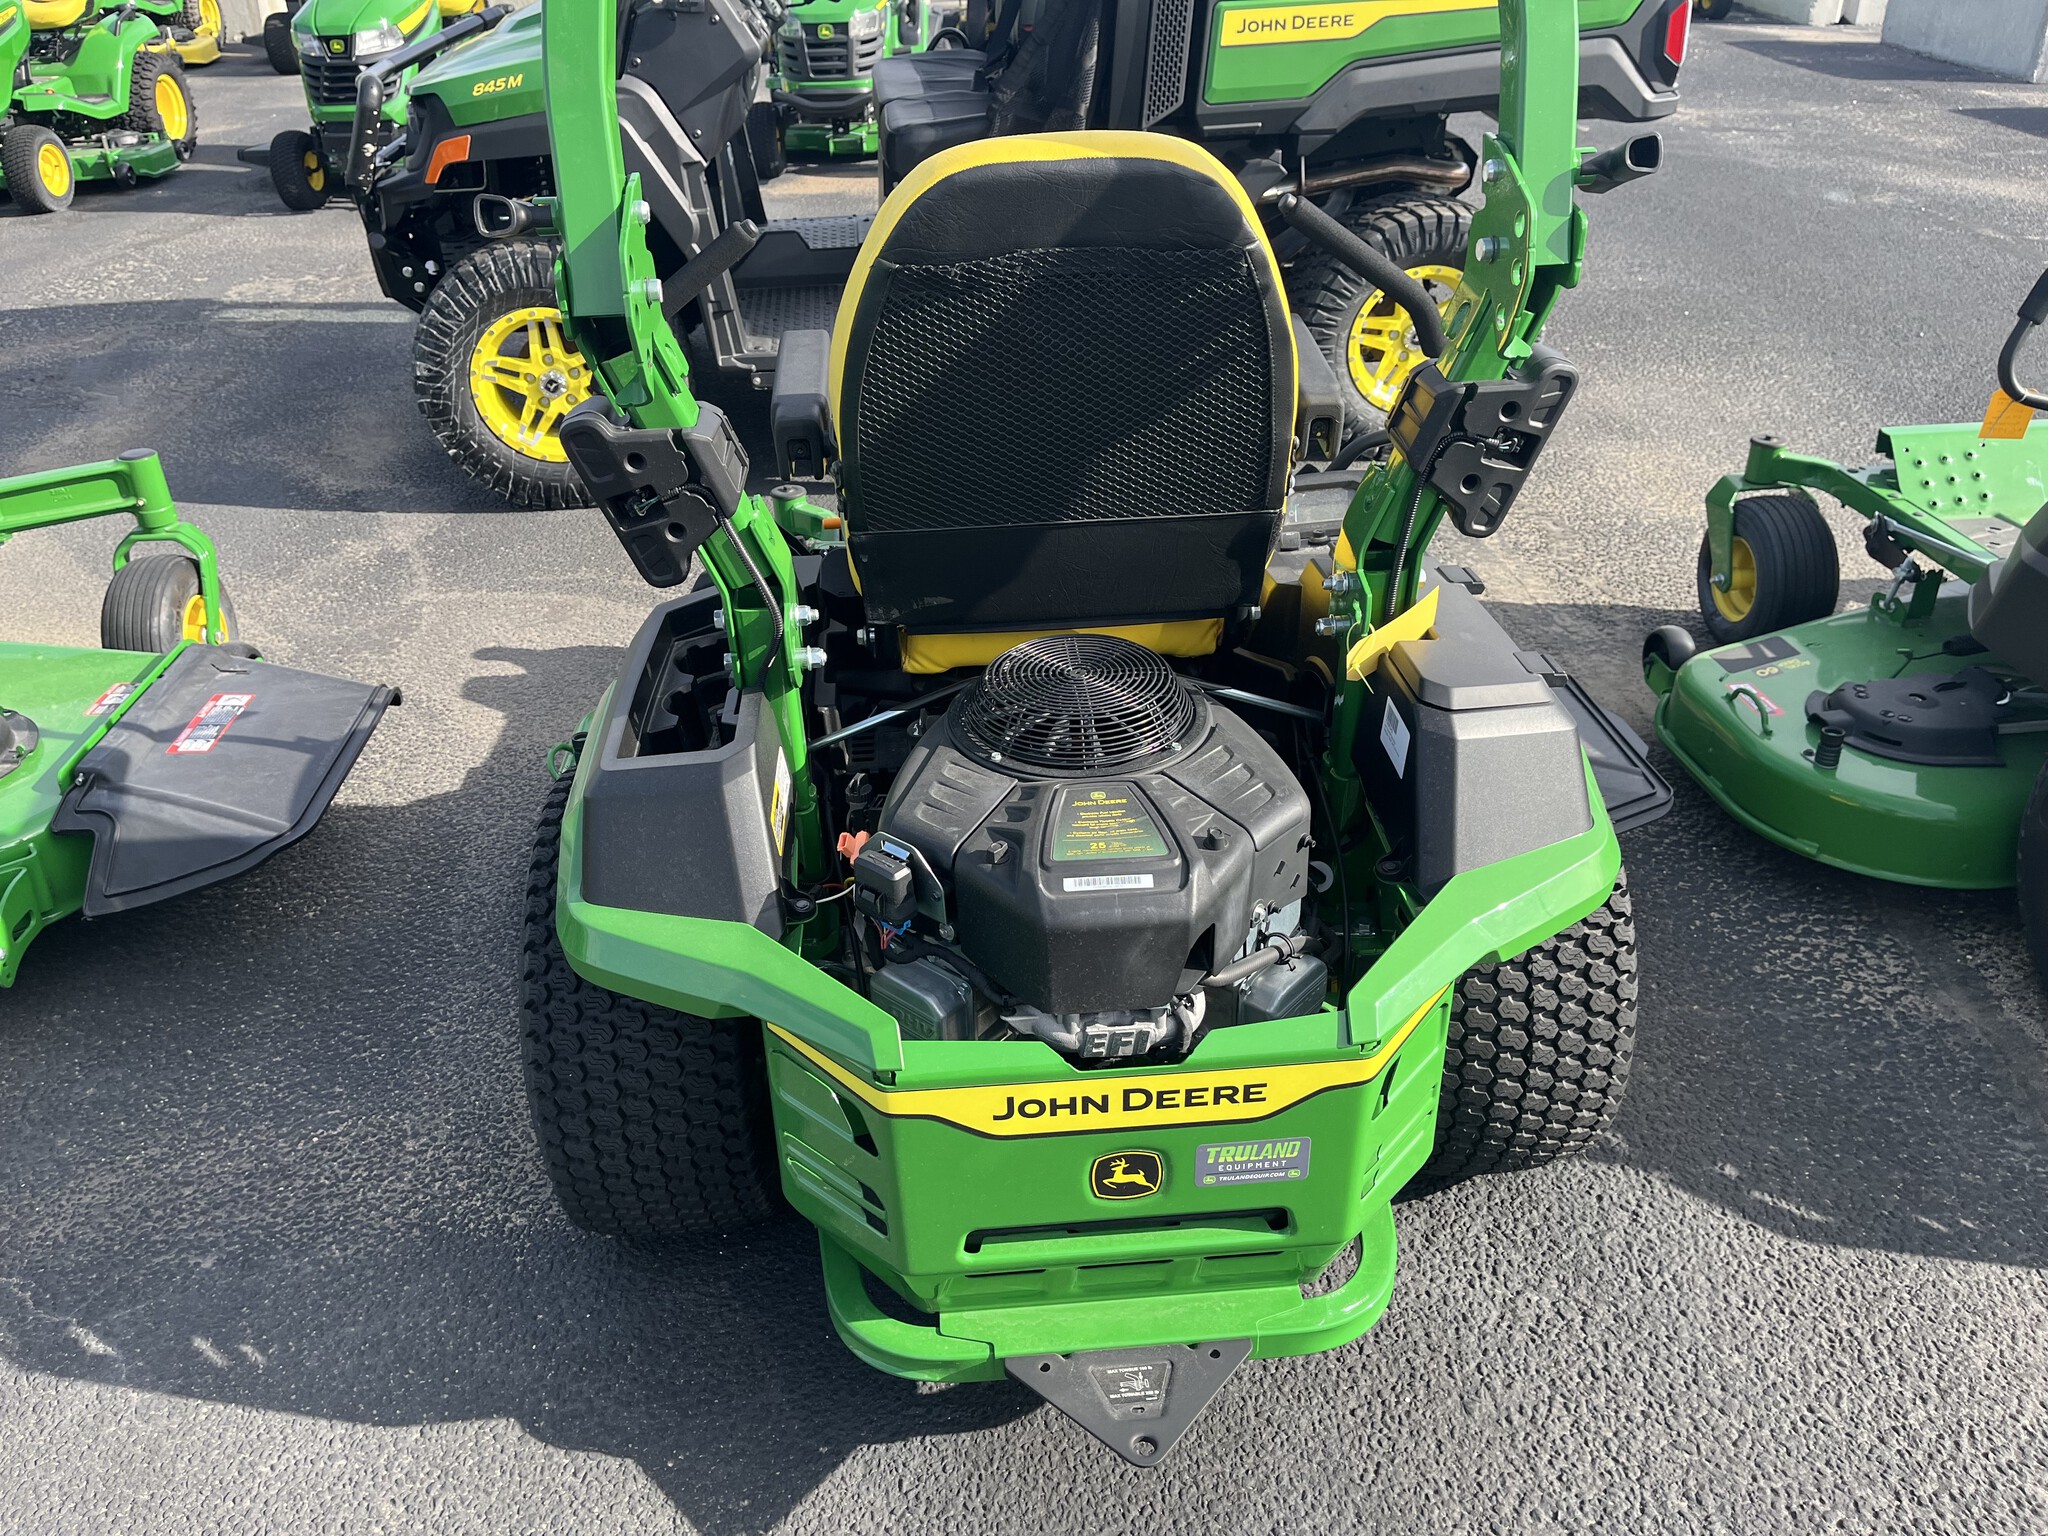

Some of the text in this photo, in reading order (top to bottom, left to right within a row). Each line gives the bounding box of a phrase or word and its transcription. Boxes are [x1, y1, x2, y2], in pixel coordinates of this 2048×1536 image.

[1237, 14, 1355, 34] JOHN DEERE
[472, 73, 524, 97] 845M
[1083, 1029, 1152, 1057] EFI
[992, 1083, 1268, 1121] JOHN DEERE
[1206, 1141, 1301, 1164] TRULAND
[1218, 1160, 1287, 1172] EQUIPMENT
[1218, 1171, 1286, 1182] TRULANDEQUIP.COM
